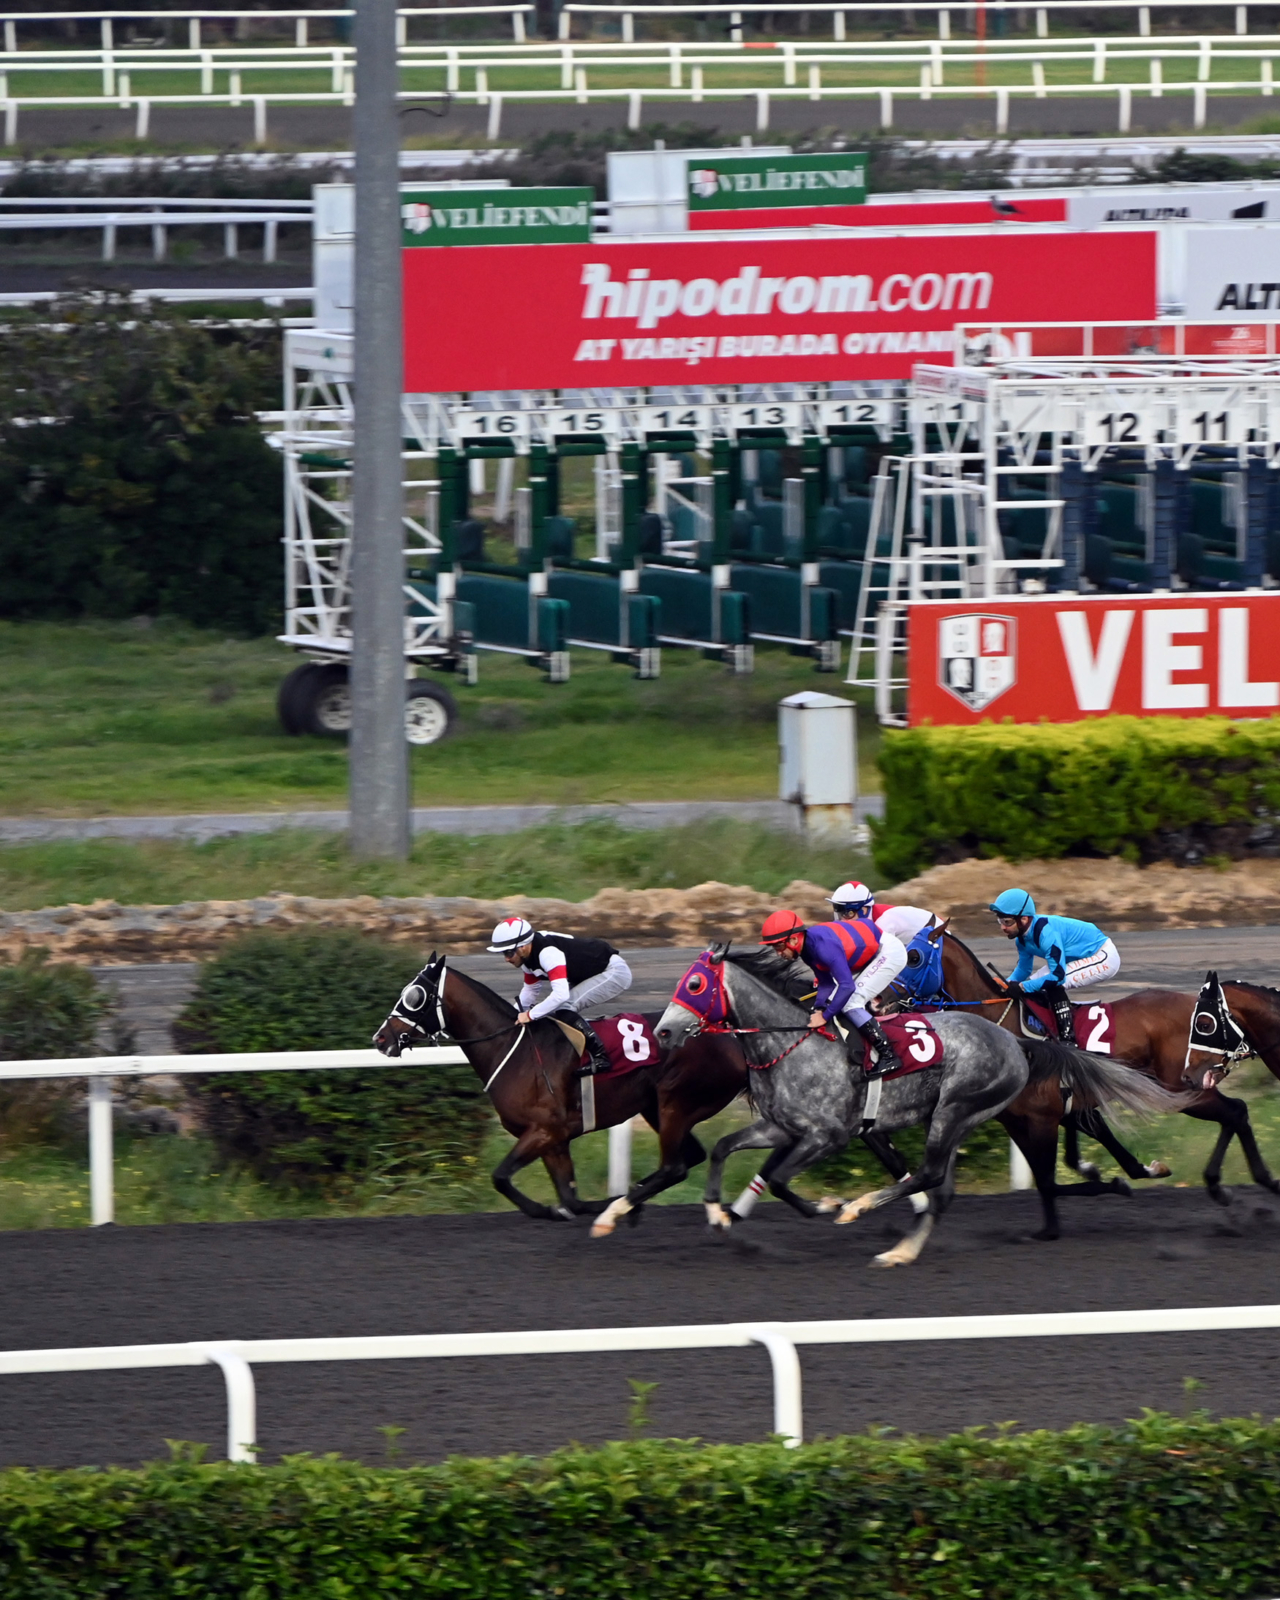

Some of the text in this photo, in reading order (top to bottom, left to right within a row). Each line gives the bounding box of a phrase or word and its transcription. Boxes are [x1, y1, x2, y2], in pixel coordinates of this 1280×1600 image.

[431, 201, 588, 228] VELİEFENDİ
[580, 263, 994, 329] hipodrom.com
[573, 339, 617, 361] AT
[620, 336, 717, 365] YARIŞI
[717, 333, 839, 358] BURADA
[473, 416, 516, 433] 16
[563, 413, 605, 431] 15
[655, 410, 698, 427] 14
[744, 407, 787, 425] 13
[834, 404, 878, 422] 12
[1098, 412, 1139, 443] 12
[1193, 410, 1231, 441] 11
[616, 1018, 651, 1062] 8
[904, 1020, 936, 1062] 3
[1086, 1005, 1112, 1054] 2
